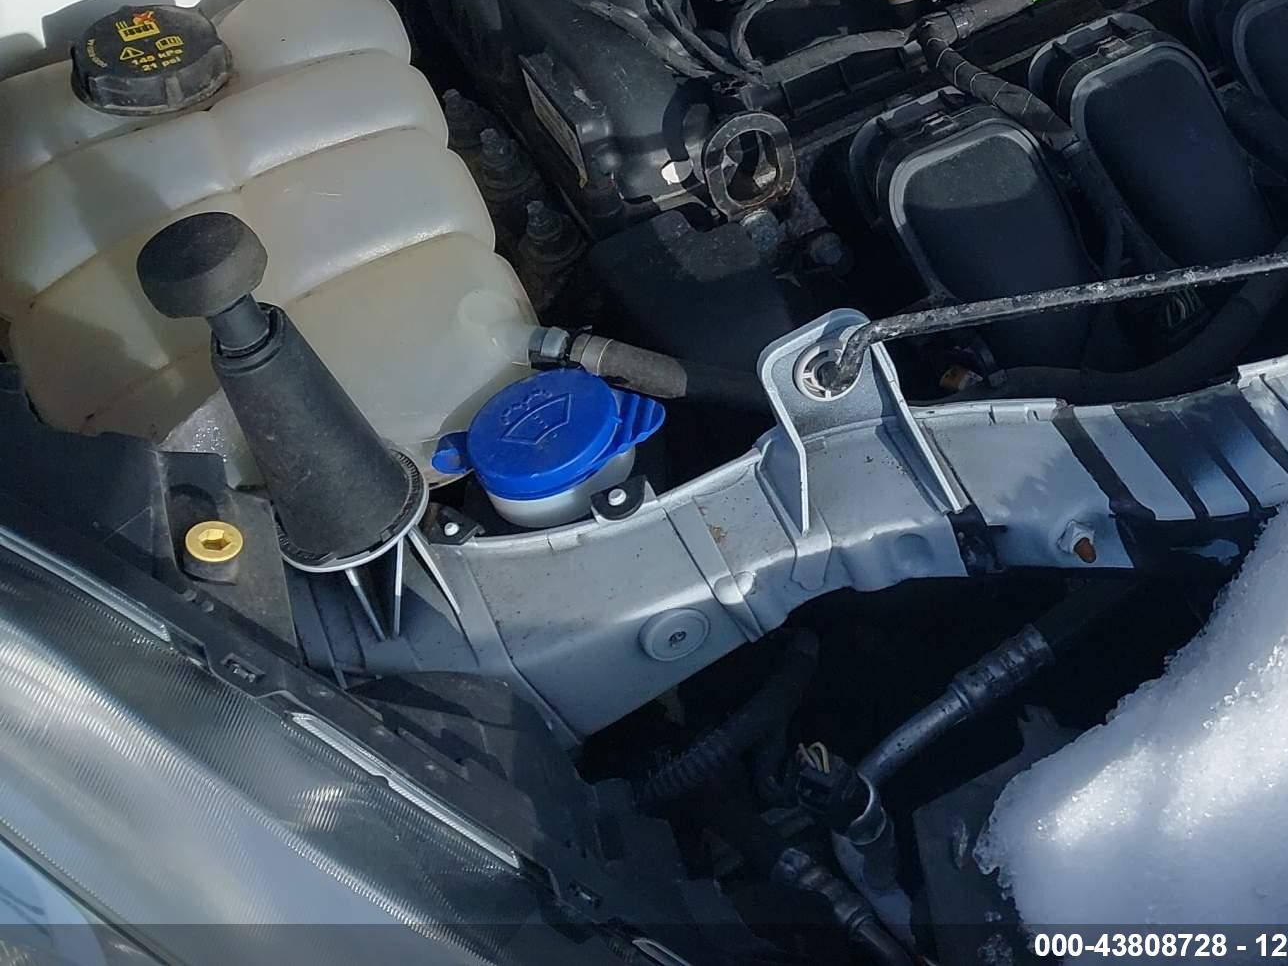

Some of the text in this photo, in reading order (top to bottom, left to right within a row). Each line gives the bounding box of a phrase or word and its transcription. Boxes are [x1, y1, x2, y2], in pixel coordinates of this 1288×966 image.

[157, 48, 184, 59] kPa
[142, 56, 182, 72] 21 psi
